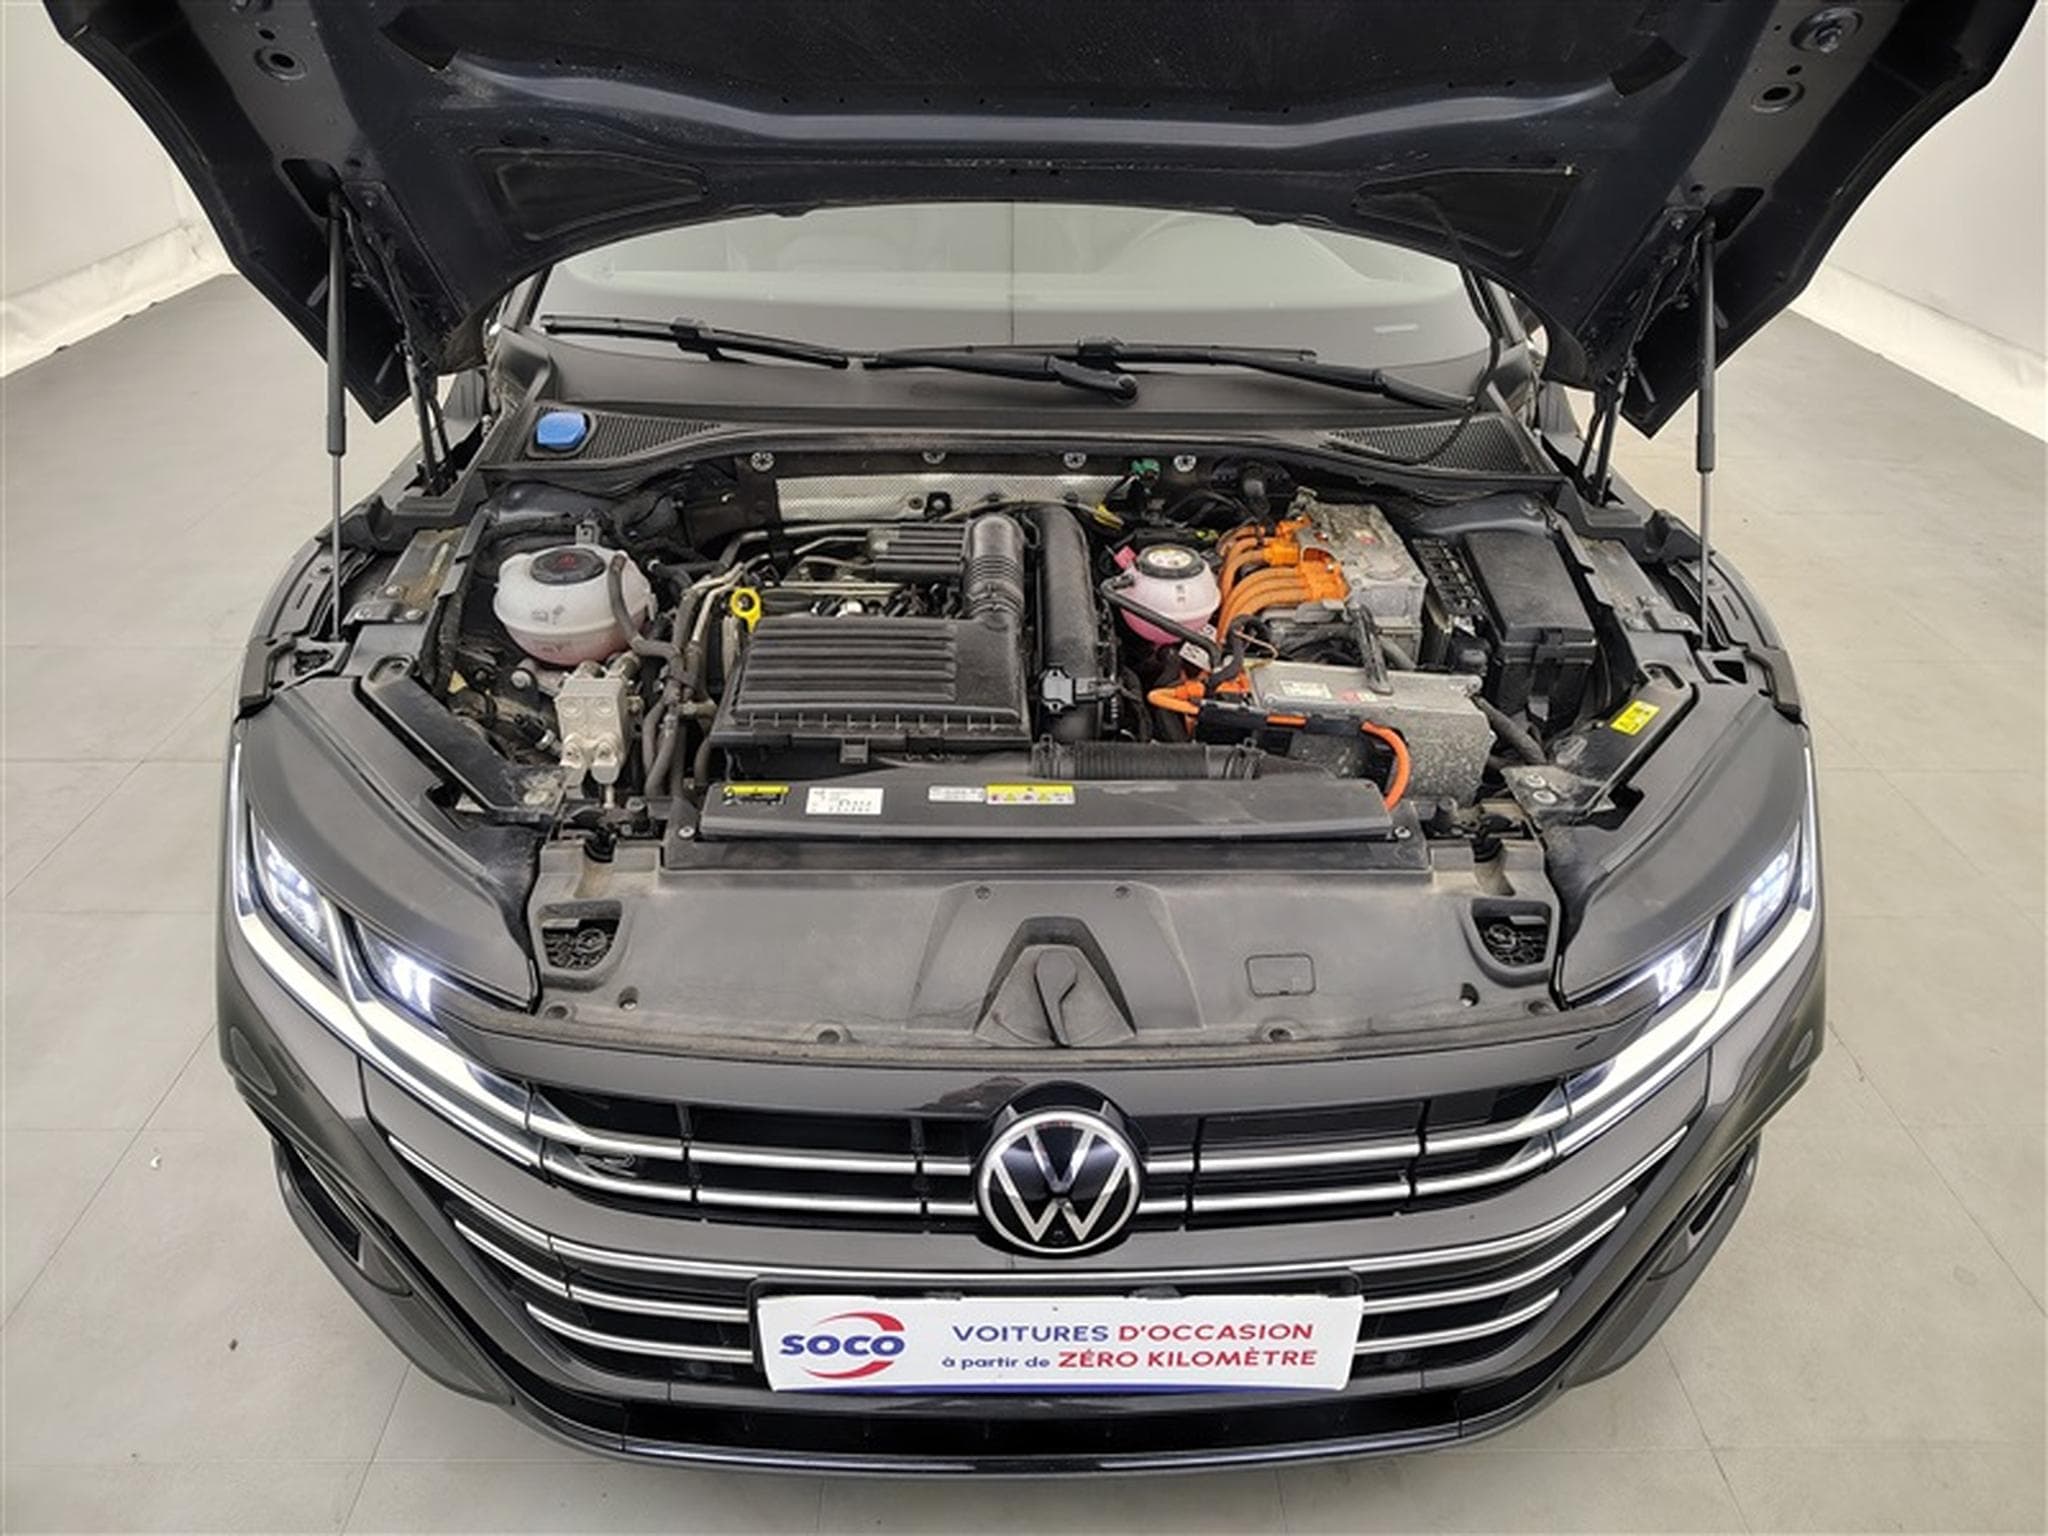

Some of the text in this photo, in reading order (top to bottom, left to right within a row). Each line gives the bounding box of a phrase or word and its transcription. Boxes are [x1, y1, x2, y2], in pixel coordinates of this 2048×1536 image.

[952, 1324, 1313, 1343] VOITURES D'OCCASION
[780, 1335, 905, 1357] SOCO
[942, 1347, 1318, 1371] à partir de ZÉRO KILOMÈTRE
